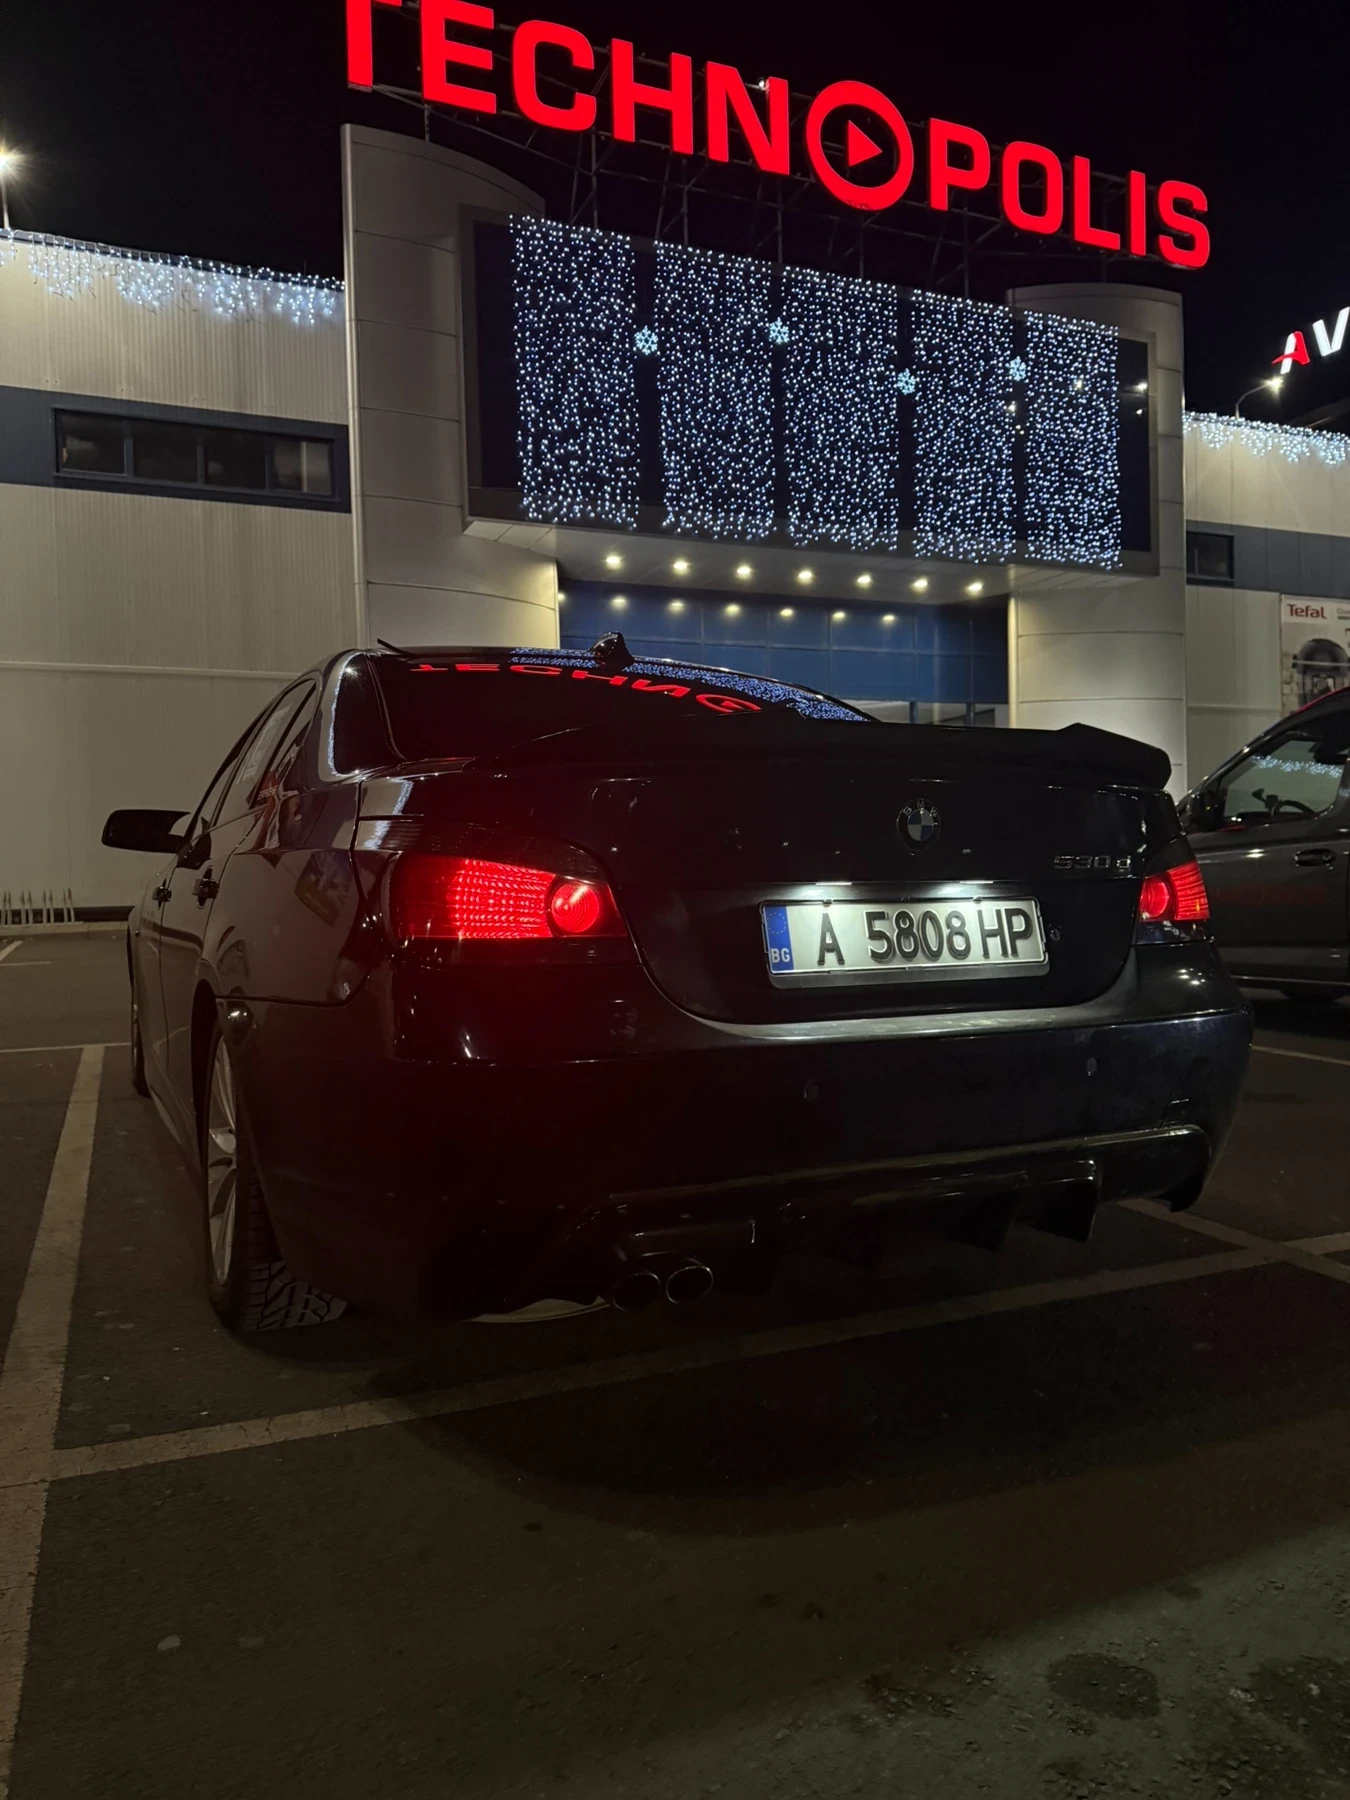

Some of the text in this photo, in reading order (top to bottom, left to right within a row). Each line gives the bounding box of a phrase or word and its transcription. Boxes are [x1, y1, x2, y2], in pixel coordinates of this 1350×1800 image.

[345, 0, 1210, 268] TECHNOPOLIS
[1286, 603, 1327, 619] Tefal
[770, 947, 791, 964] BG
[817, 907, 1033, 966] A 5808 HP
